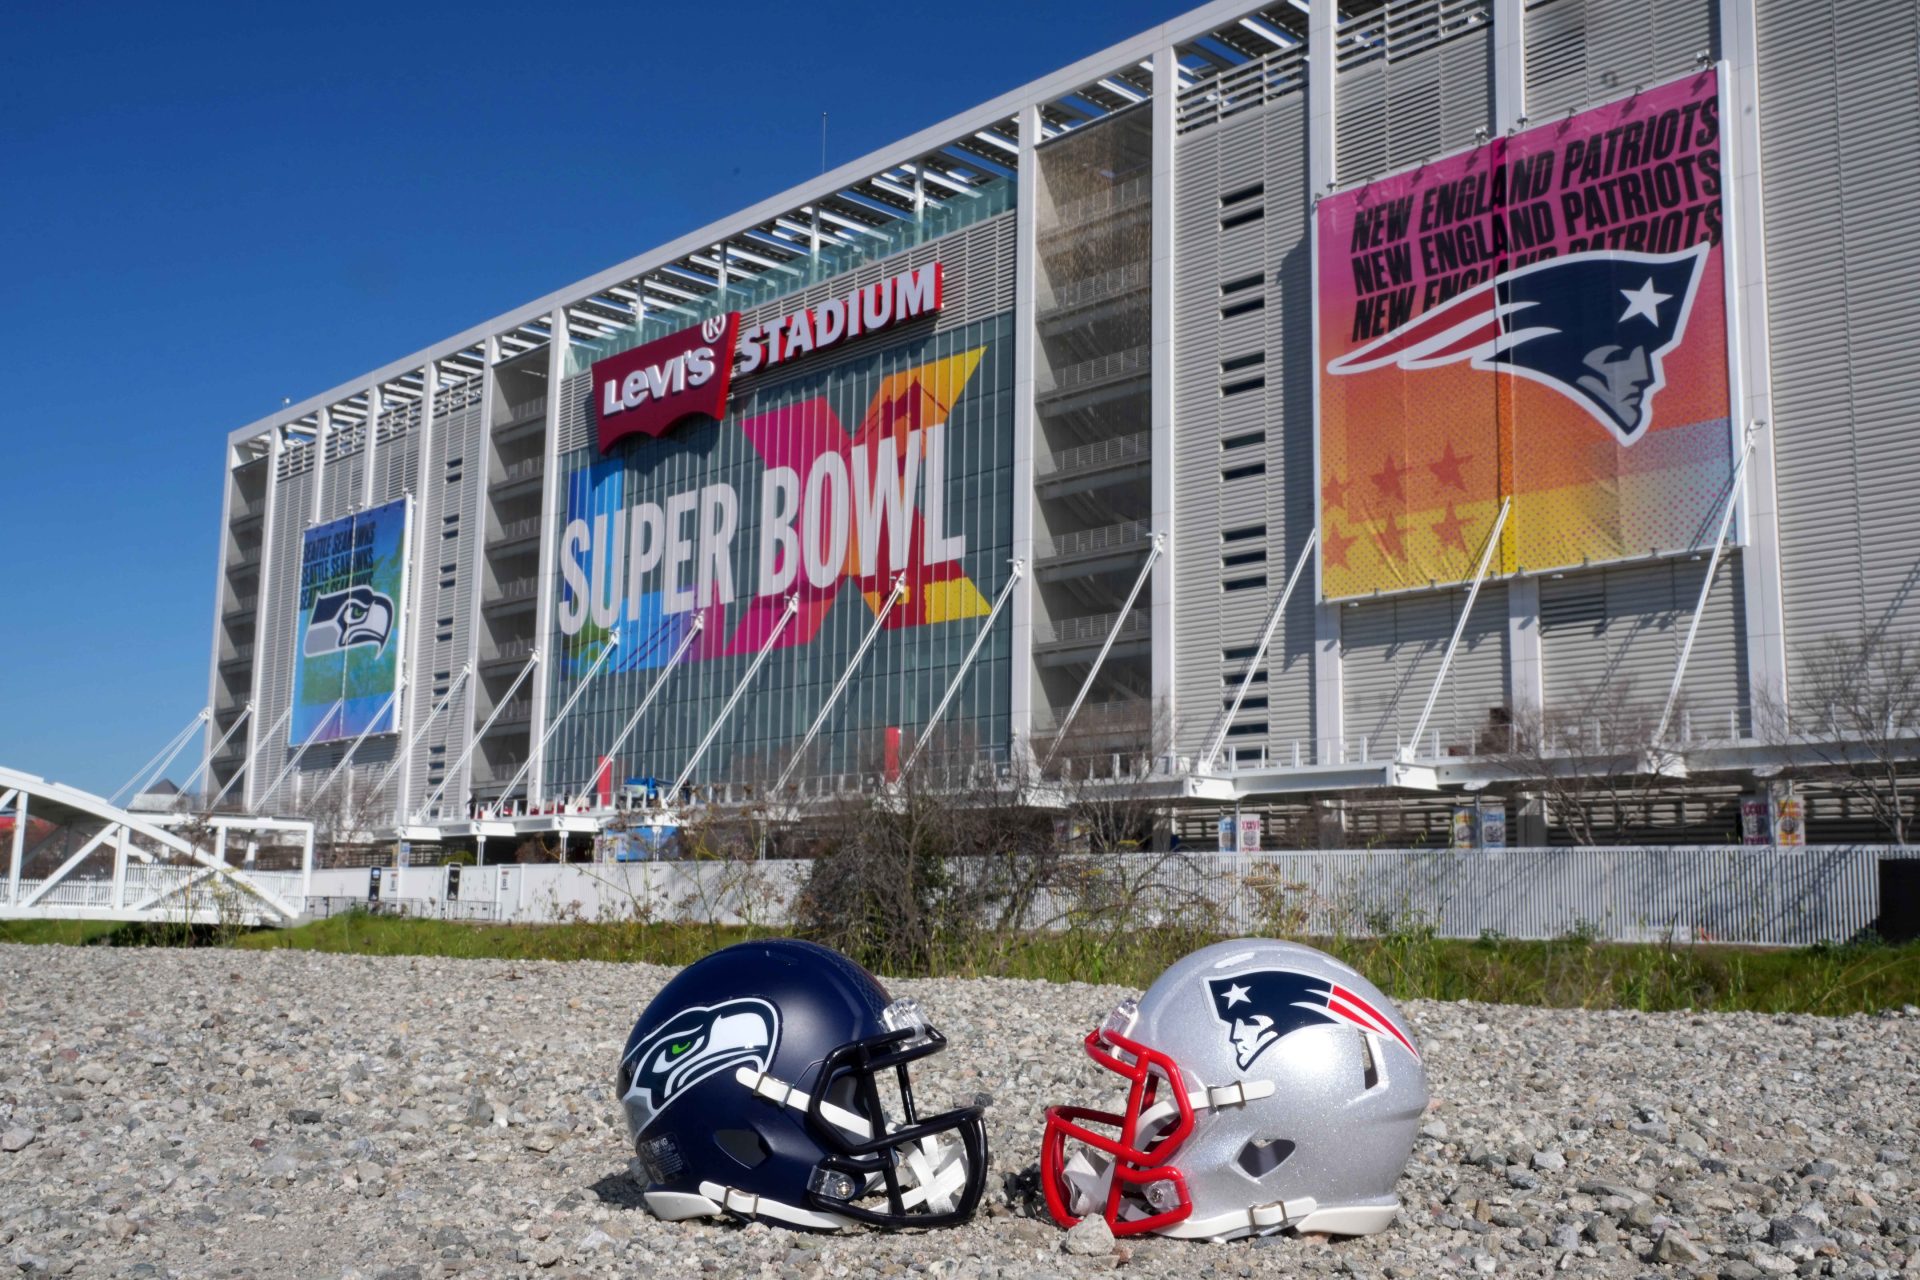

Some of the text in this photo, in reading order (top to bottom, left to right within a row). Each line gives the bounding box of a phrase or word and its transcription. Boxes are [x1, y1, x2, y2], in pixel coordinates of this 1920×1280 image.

[1351, 95, 1719, 253] NEW ENGLAND PATRIOTS
[1352, 149, 1721, 296] NEW ENGLAND PATRIOTS
[740, 262, 942, 373] STADIUM
[1352, 285, 1416, 342] NEW
[302, 558, 330, 588] SEATTLE
[304, 536, 332, 564] SEATTLE
[559, 423, 966, 635] SUPER BOWL
